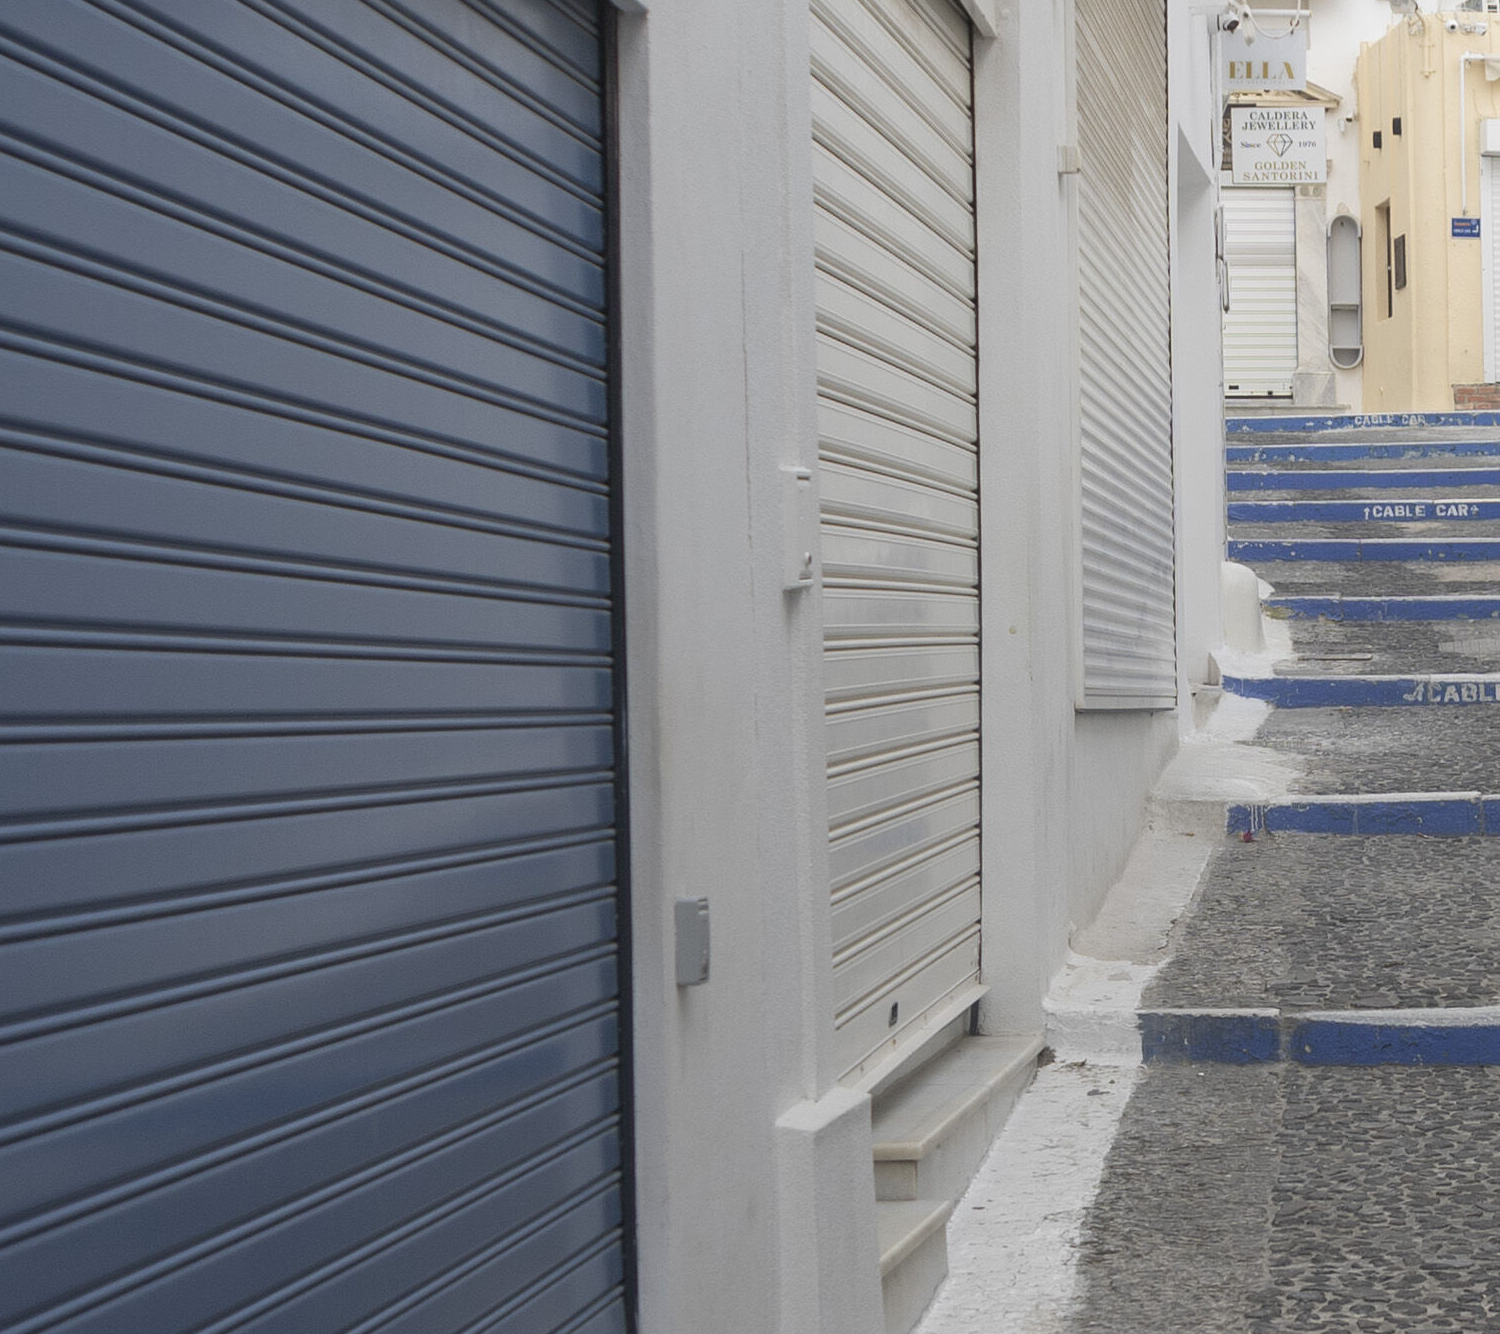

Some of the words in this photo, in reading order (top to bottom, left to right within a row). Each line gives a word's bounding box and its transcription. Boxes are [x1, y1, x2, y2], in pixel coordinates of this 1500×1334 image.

[1228, 61, 1295, 80] ELLA
[1249, 111, 1309, 121] CALDERA
[1241, 121, 1317, 131] JEWELLERY
[1254, 161, 1307, 171] GOLDEN
[1243, 171, 1319, 181] SANTORINI
[1372, 505, 1426, 518] CABLE
[1436, 504, 1469, 516] CAR
